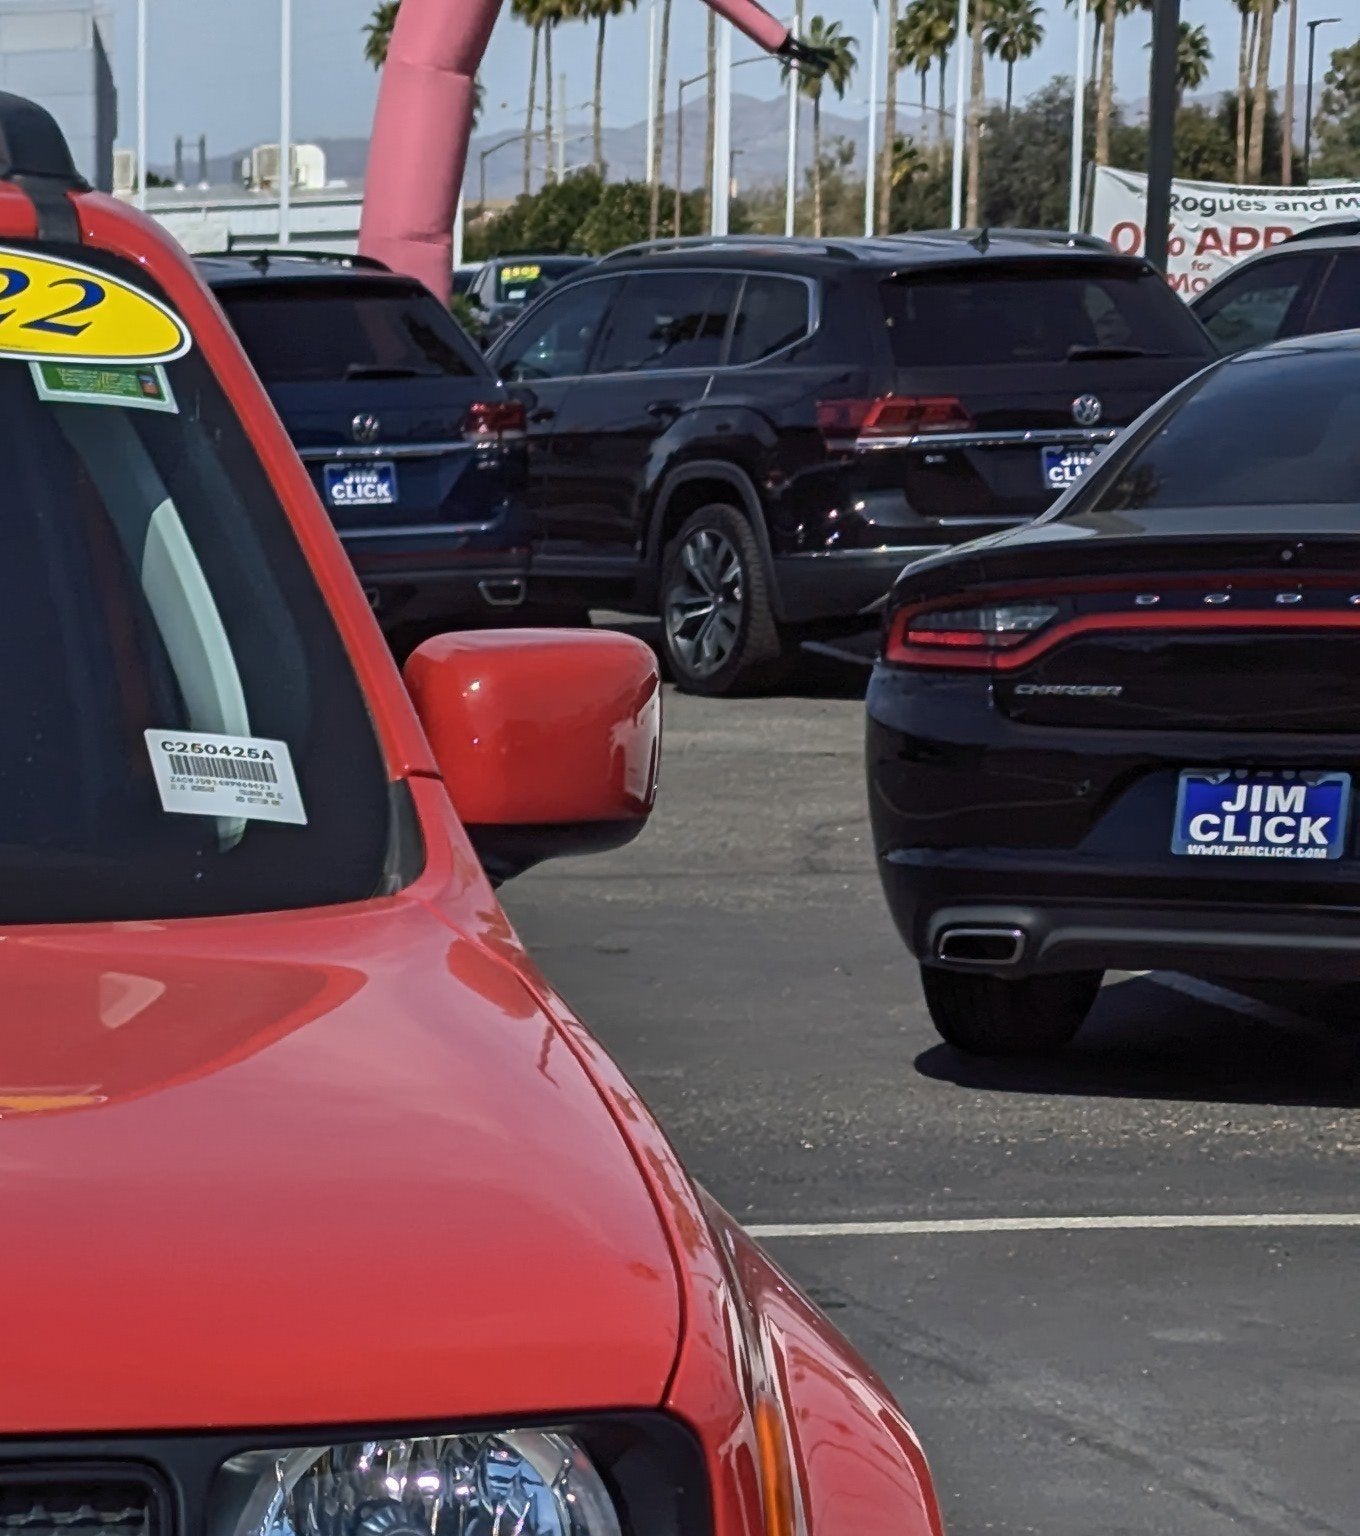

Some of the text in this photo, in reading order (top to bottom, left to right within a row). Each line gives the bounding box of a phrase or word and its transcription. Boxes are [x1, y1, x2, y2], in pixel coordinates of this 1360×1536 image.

[1274, 198, 1328, 212] and
[1191, 259, 1213, 271] for
[331, 482, 390, 499] CLICK
[1014, 684, 1122, 696] CHARGER
[1221, 784, 1307, 813] JIM
[1189, 813, 1332, 845] CLICK
[1187, 844, 1328, 859] WWW.JIMCLICK.COM
